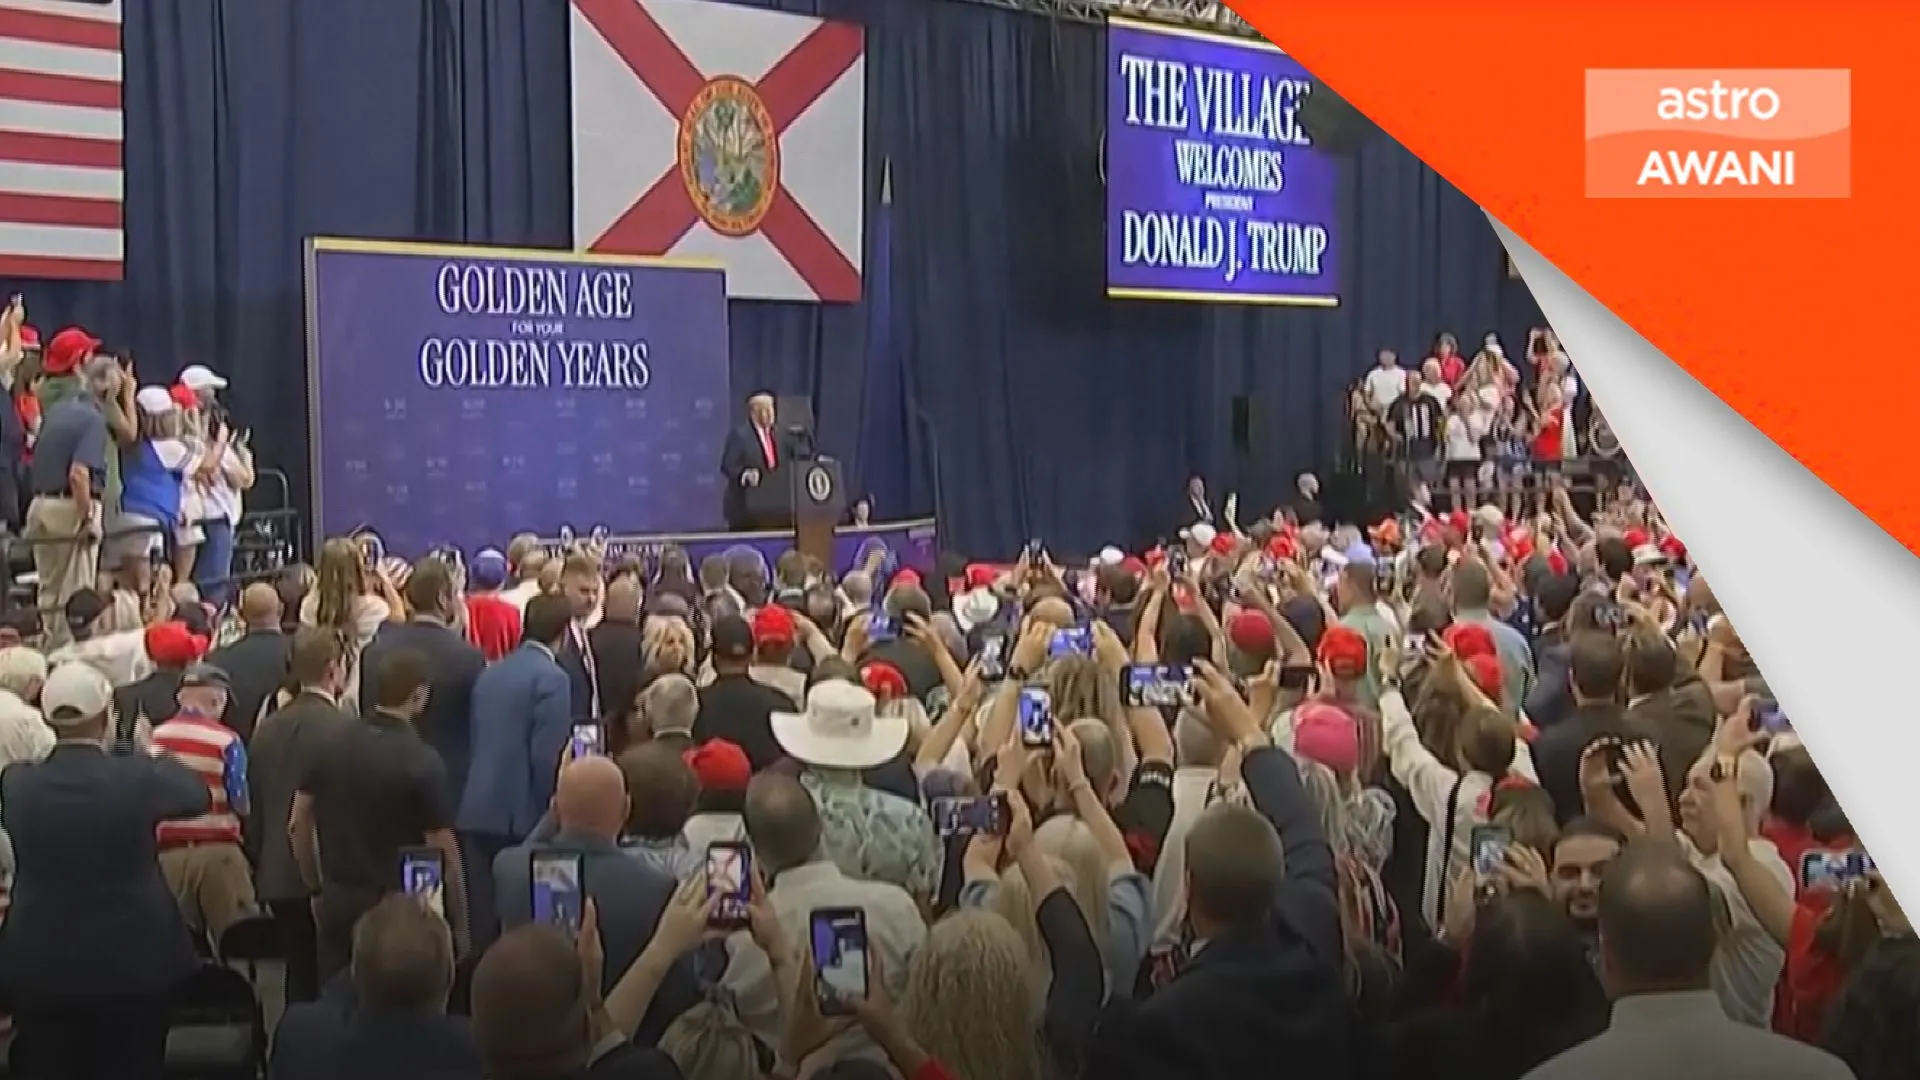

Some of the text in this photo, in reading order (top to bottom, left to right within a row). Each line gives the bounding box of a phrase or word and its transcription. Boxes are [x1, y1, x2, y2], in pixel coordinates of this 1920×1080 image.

[1121, 54, 1189, 129] THE
[1175, 139, 1284, 192] WELCOMES
[1122, 210, 1328, 282] DONALD J. TRUMP
[438, 263, 633, 319] GOLDEN AGE
[512, 320, 563, 335] FOR YOUR
[420, 338, 650, 389] GOLDEN YEARS
